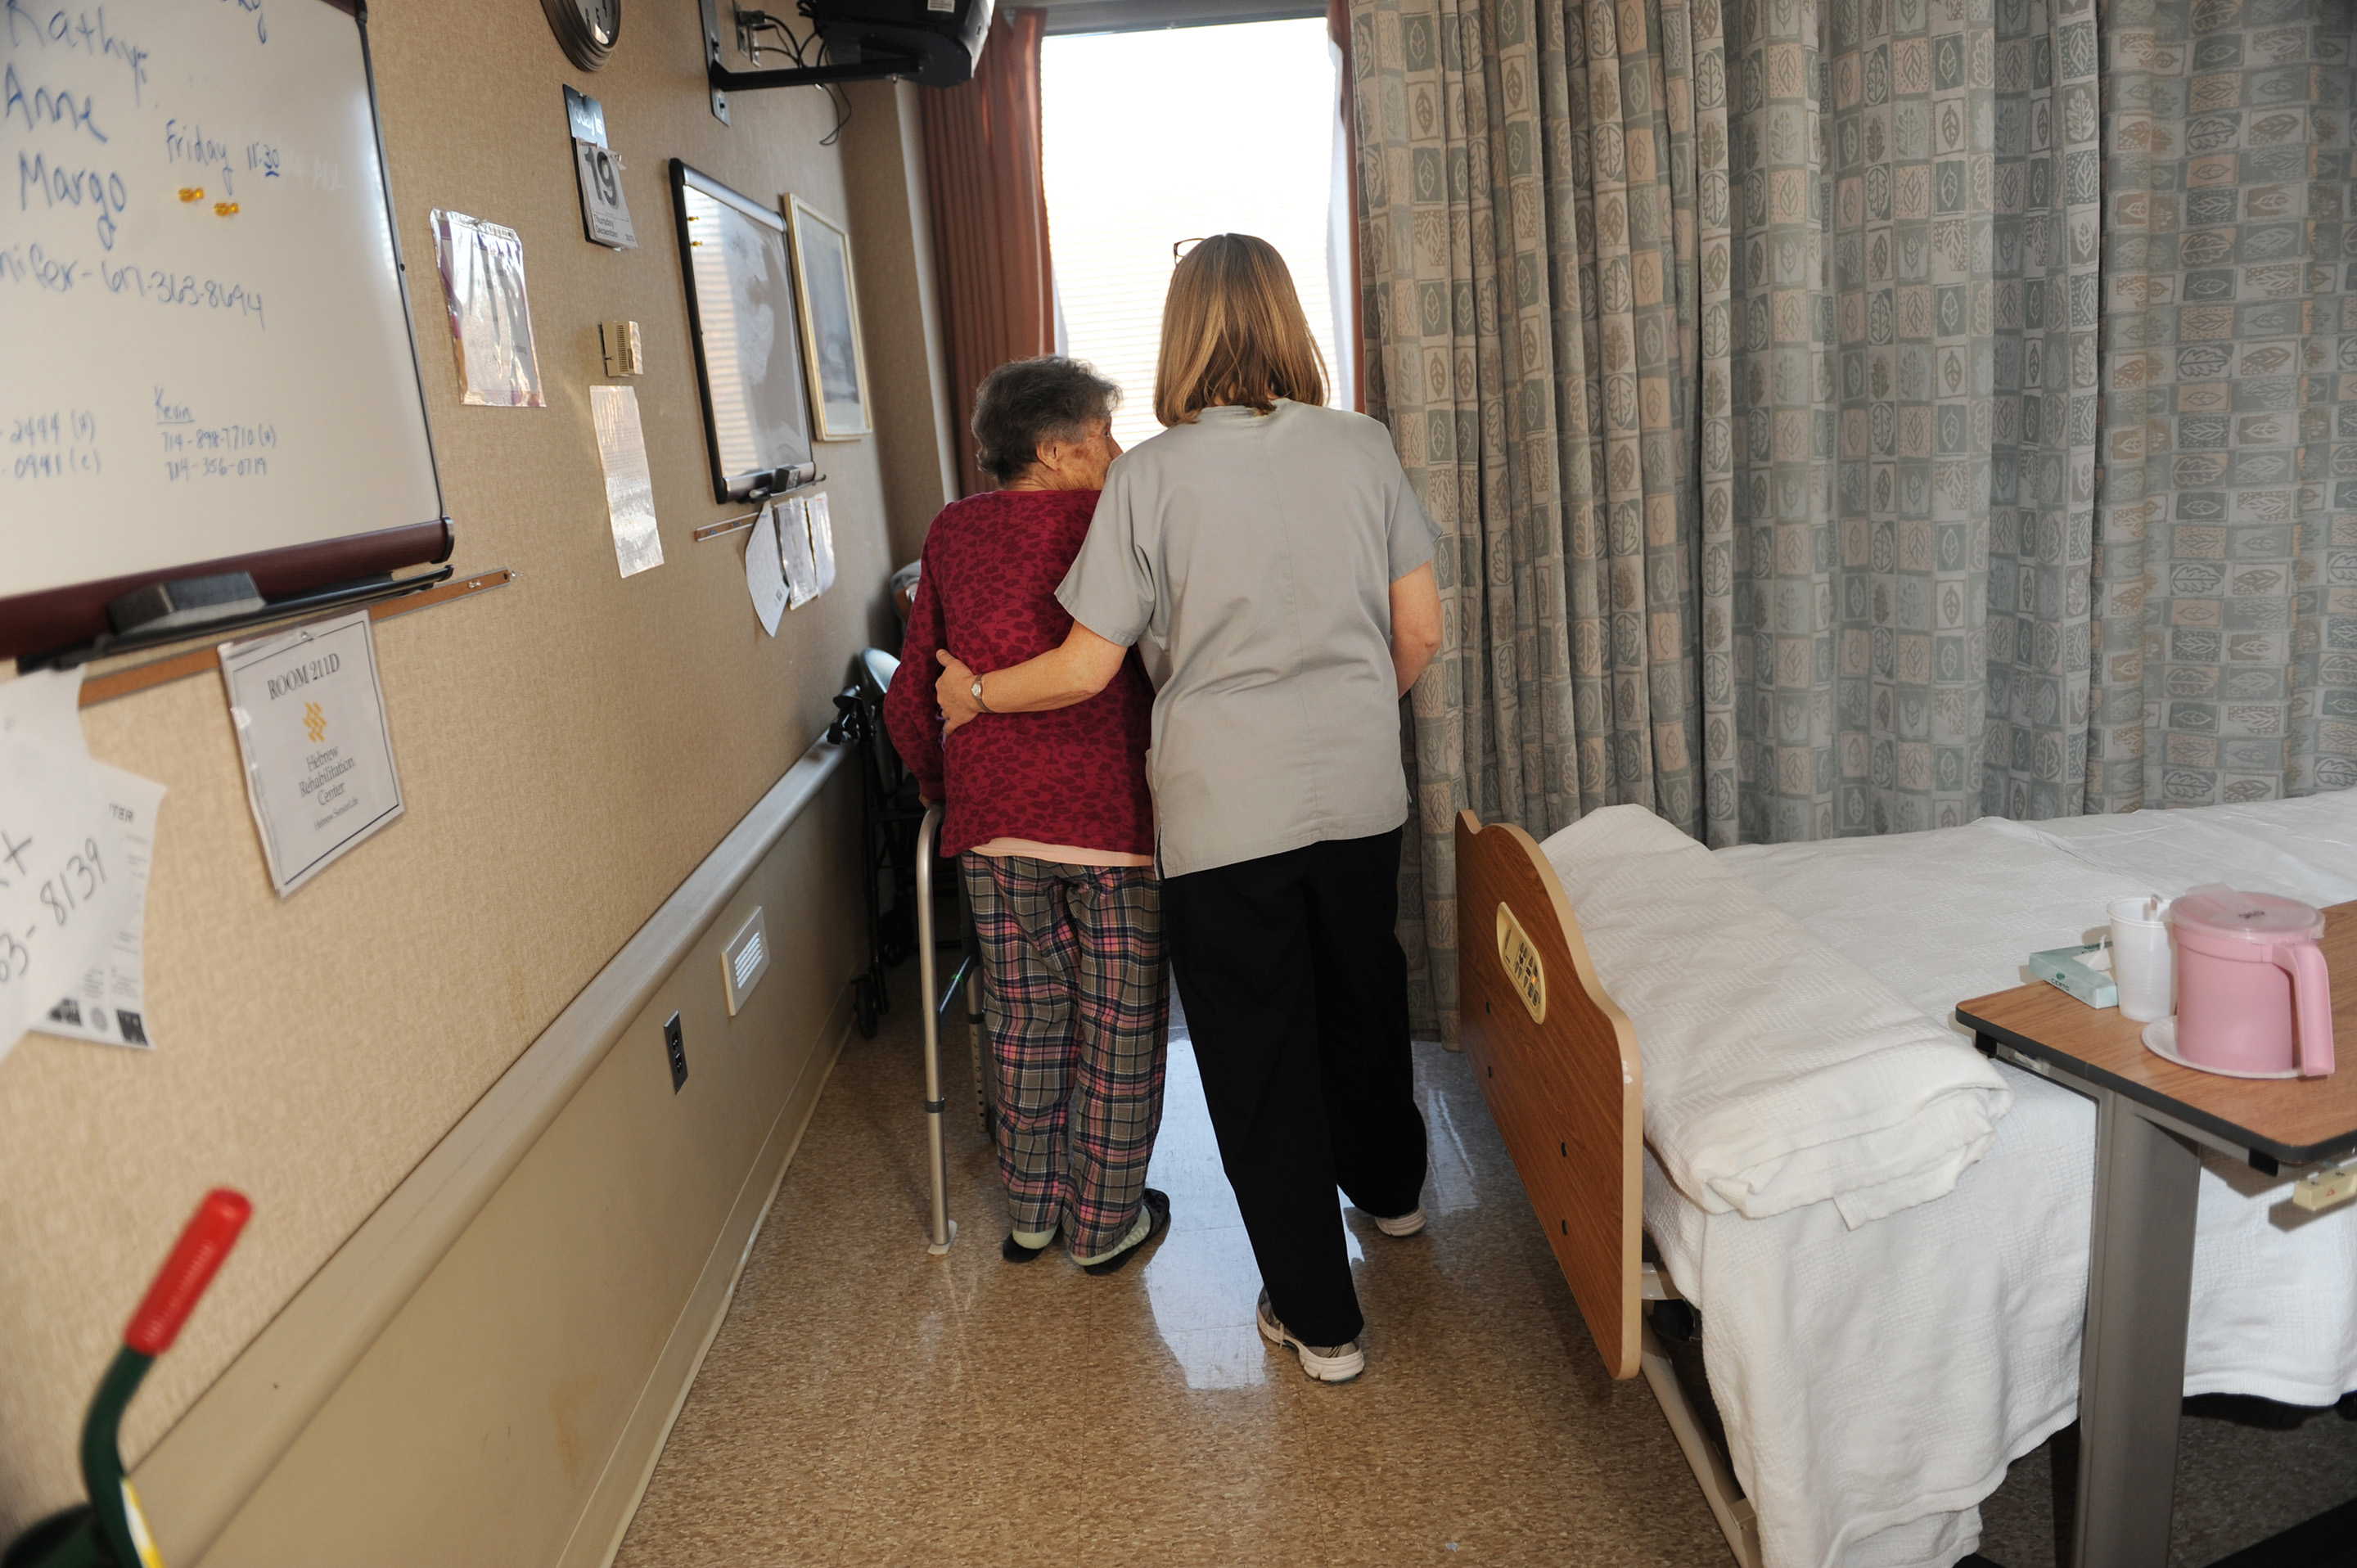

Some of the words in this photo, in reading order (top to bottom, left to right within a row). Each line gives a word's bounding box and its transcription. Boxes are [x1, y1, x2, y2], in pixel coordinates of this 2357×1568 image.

[5, 62, 107, 142] Anne
[165, 119, 234, 196] Friday
[584, 146, 618, 206] 19
[19, 151, 127, 250] Margo
[593, 214, 615, 230] Thursday
[595, 224, 619, 238] December
[154, 386, 193, 422] Kevin
[267, 665, 311, 701] ROOM
[309, 653, 340, 681] 211D
[298, 755, 355, 798] Rehabilitation
[306, 746, 339, 773] Hebrew
[108, 802, 135, 824] TER
[317, 782, 345, 806] Center
